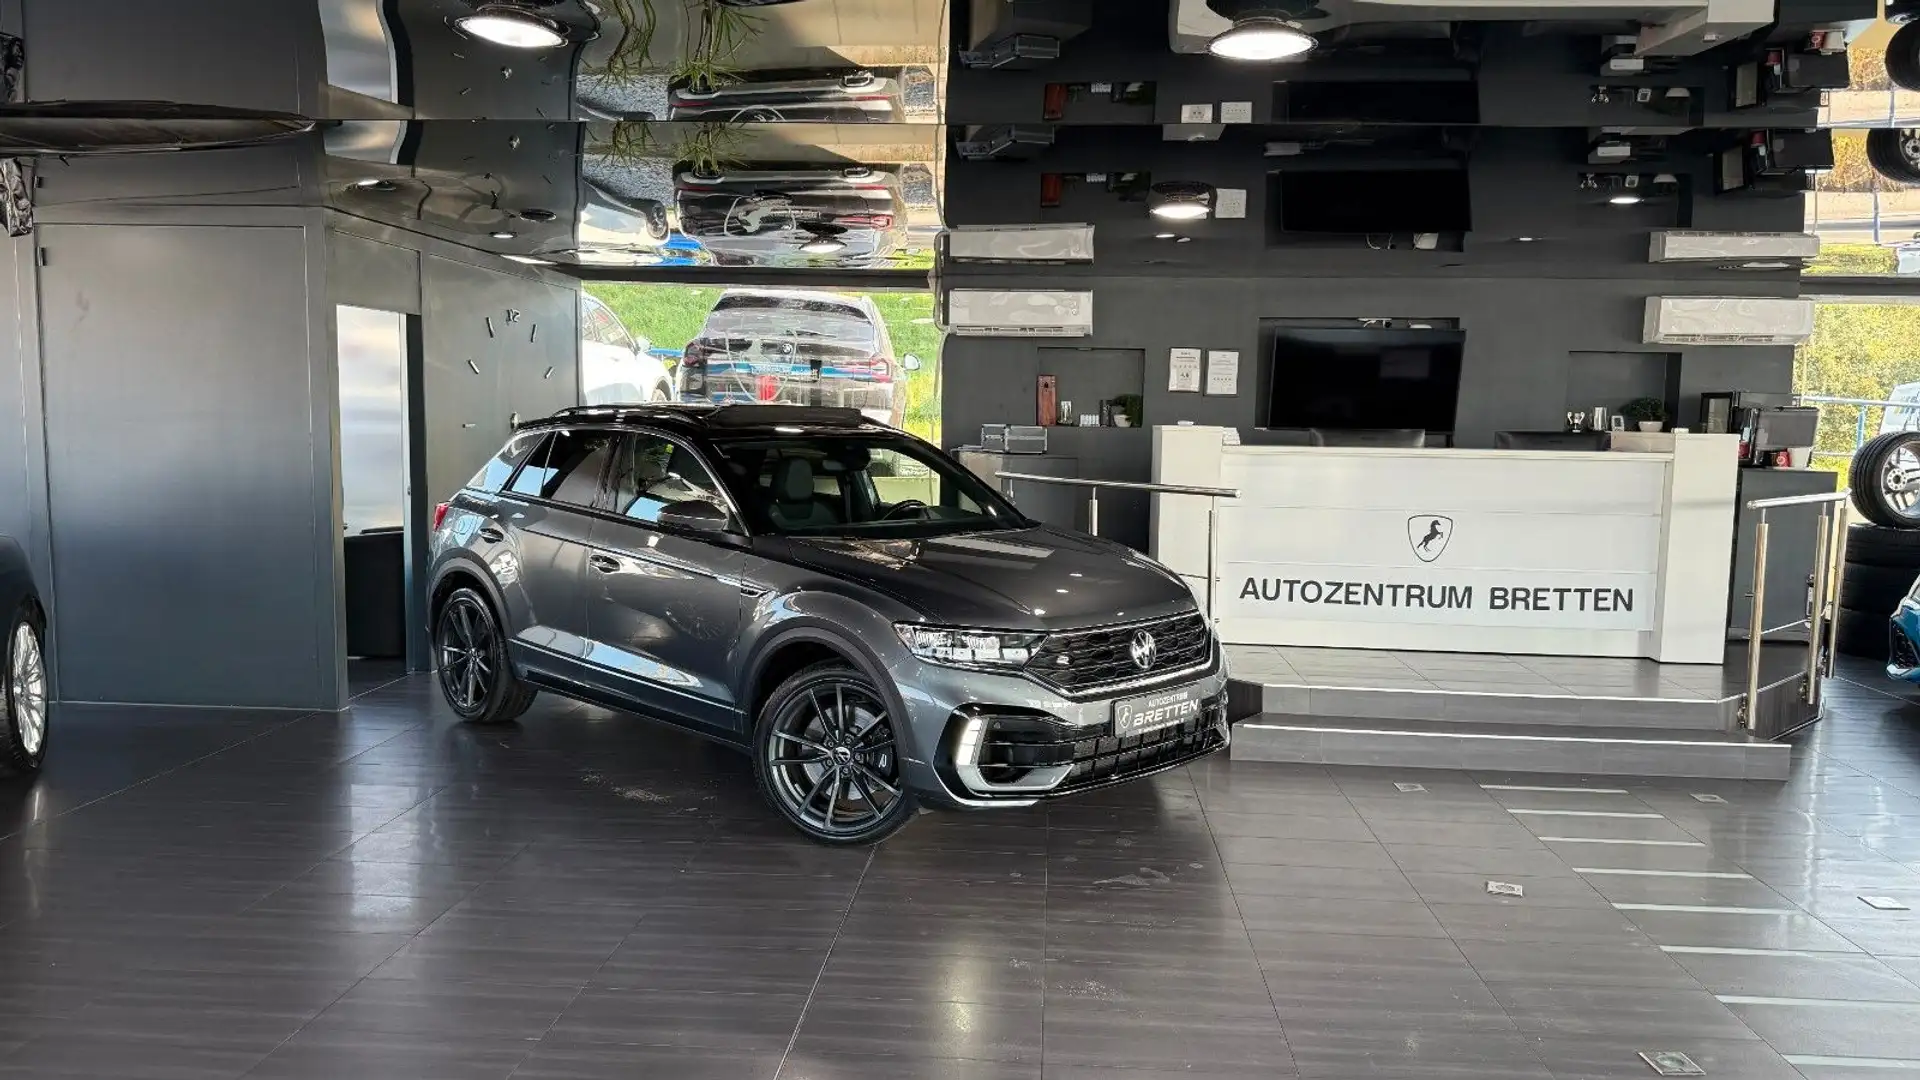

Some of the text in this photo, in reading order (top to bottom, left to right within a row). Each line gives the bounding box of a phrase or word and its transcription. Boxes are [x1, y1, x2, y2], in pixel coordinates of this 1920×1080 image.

[1239, 576, 1634, 612] AUTOZENTRUM BRETTEN
[1133, 699, 1199, 727] BRETTEN
